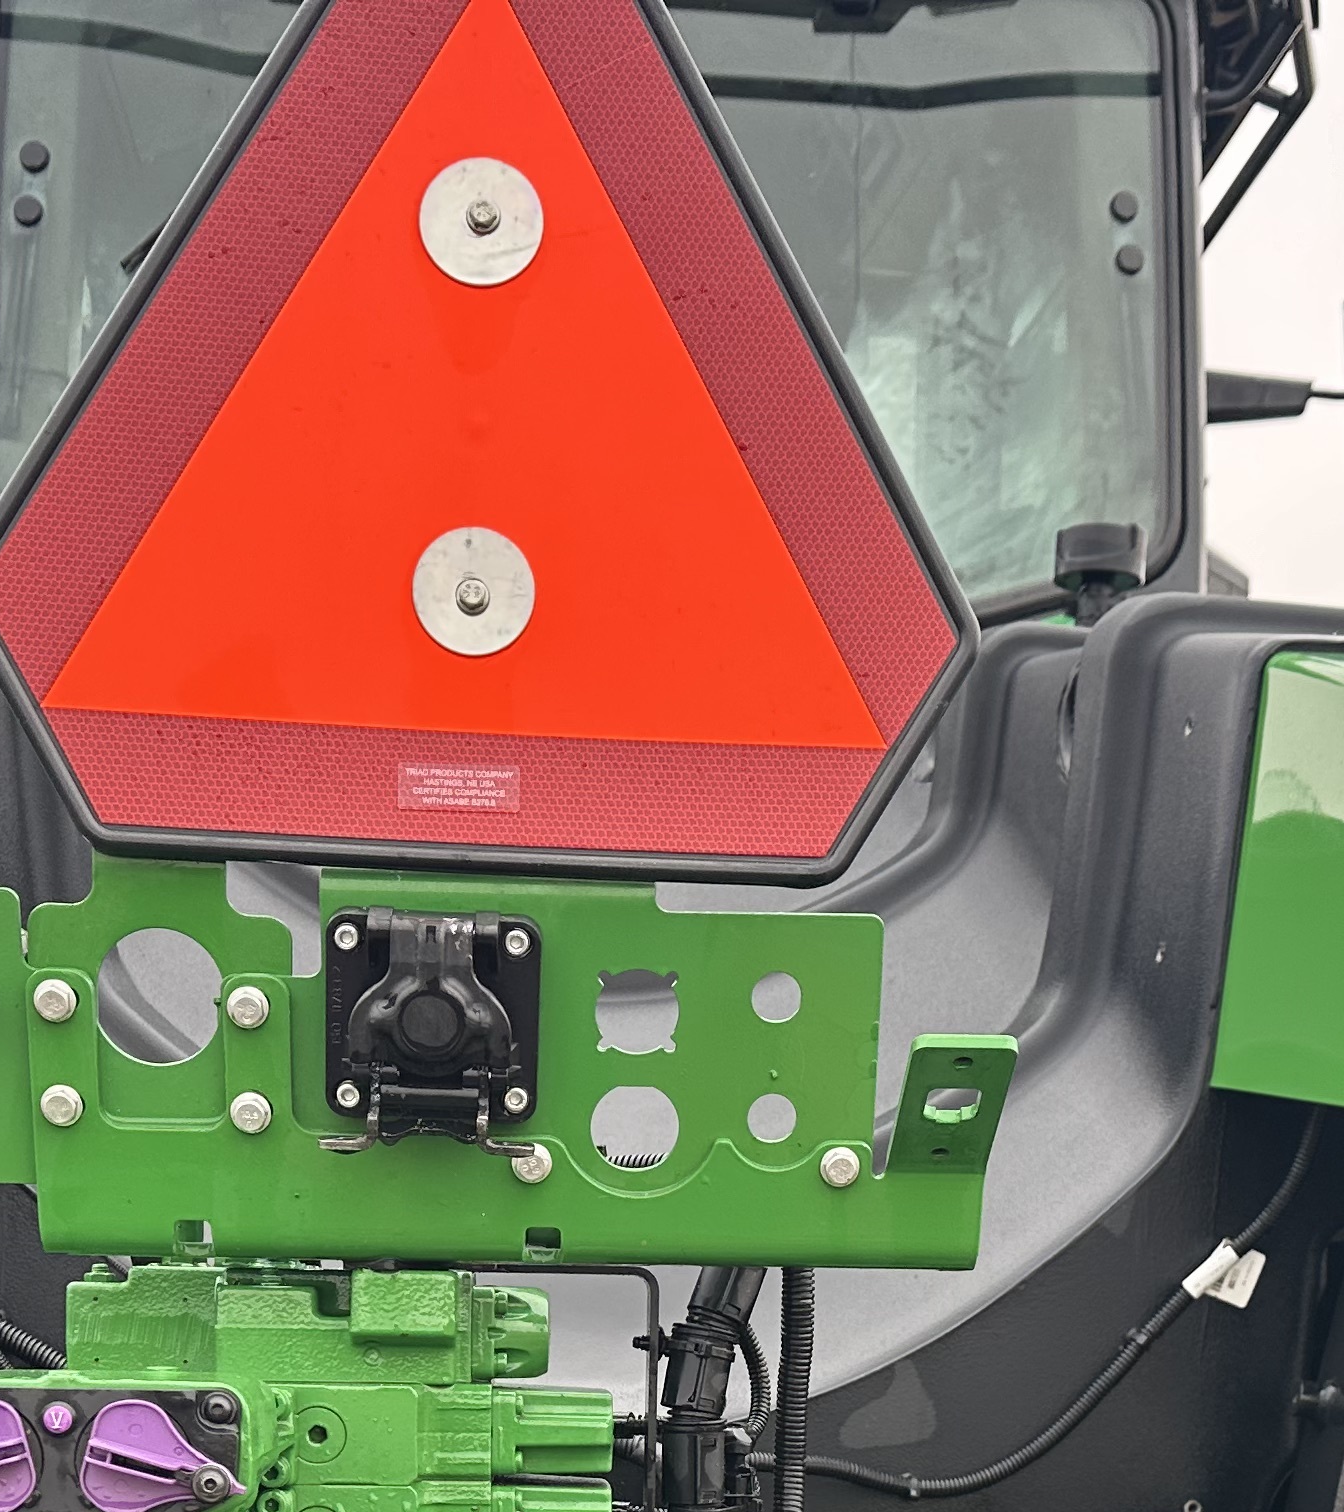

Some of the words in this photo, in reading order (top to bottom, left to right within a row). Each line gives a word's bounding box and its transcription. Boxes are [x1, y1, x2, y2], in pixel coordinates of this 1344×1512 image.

[430, 768, 474, 778] PRODUCTS
[475, 770, 514, 779] COMPANY
[412, 786, 454, 796] CERTIFIES
[455, 788, 506, 798] COMPLIANCE
[421, 796, 444, 804] WITH
[50, 1411, 64, 1429] V
